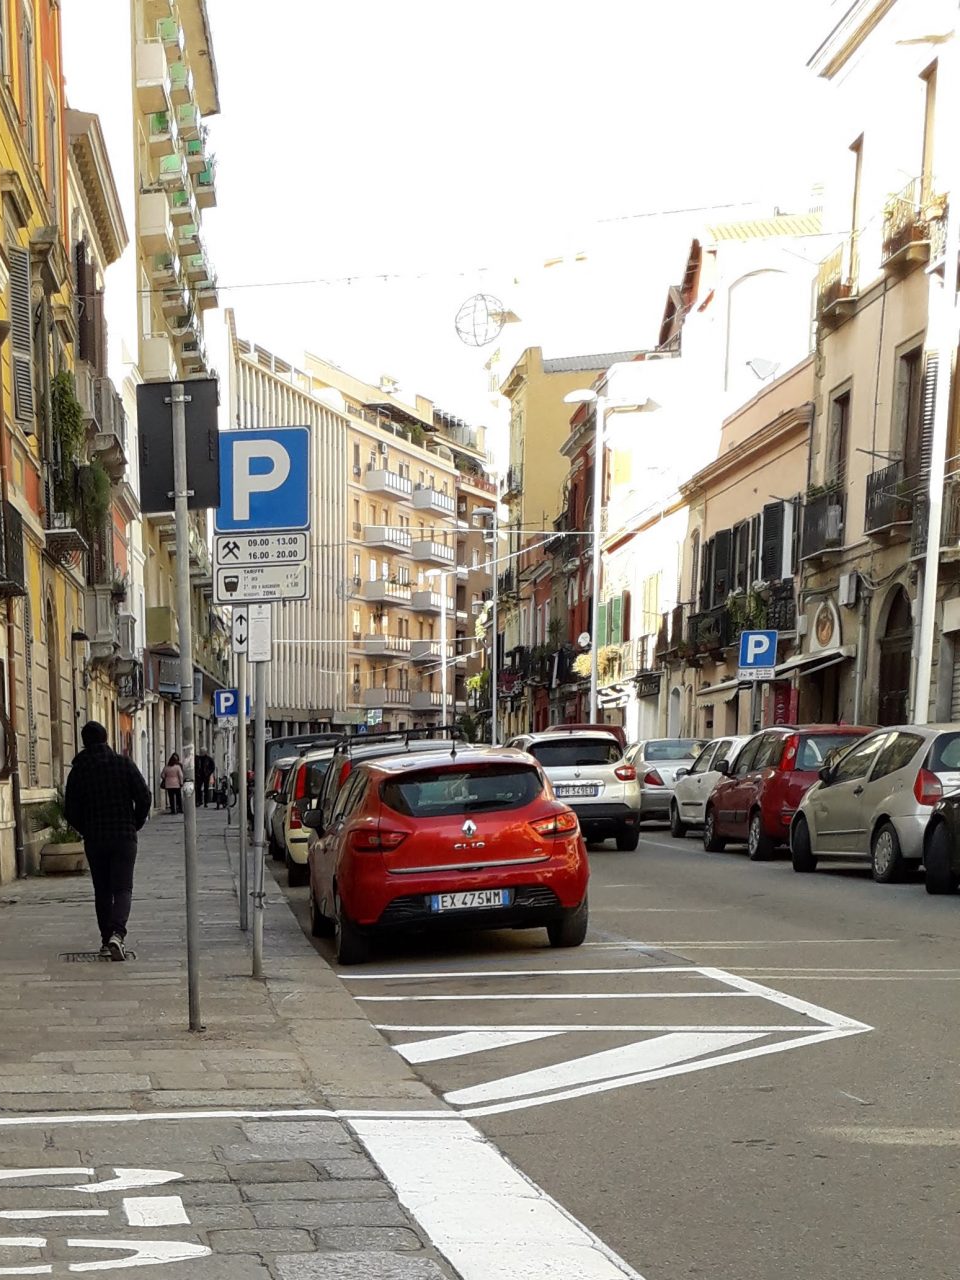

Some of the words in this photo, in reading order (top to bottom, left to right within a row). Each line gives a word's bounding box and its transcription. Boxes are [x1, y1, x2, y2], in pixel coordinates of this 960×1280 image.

[233, 439, 290, 521] P
[248, 538, 269, 547] 09.00
[277, 537, 298, 546] 13.00
[248, 551, 269, 559] 16.00
[277, 550, 298, 558] 20.00
[747, 634, 770, 663] P
[220, 692, 234, 713] P
[560, 786, 570, 795] FH
[454, 841, 486, 850] CLIO
[441, 895, 457, 909] EX
[461, 890, 502, 907] 475WM
